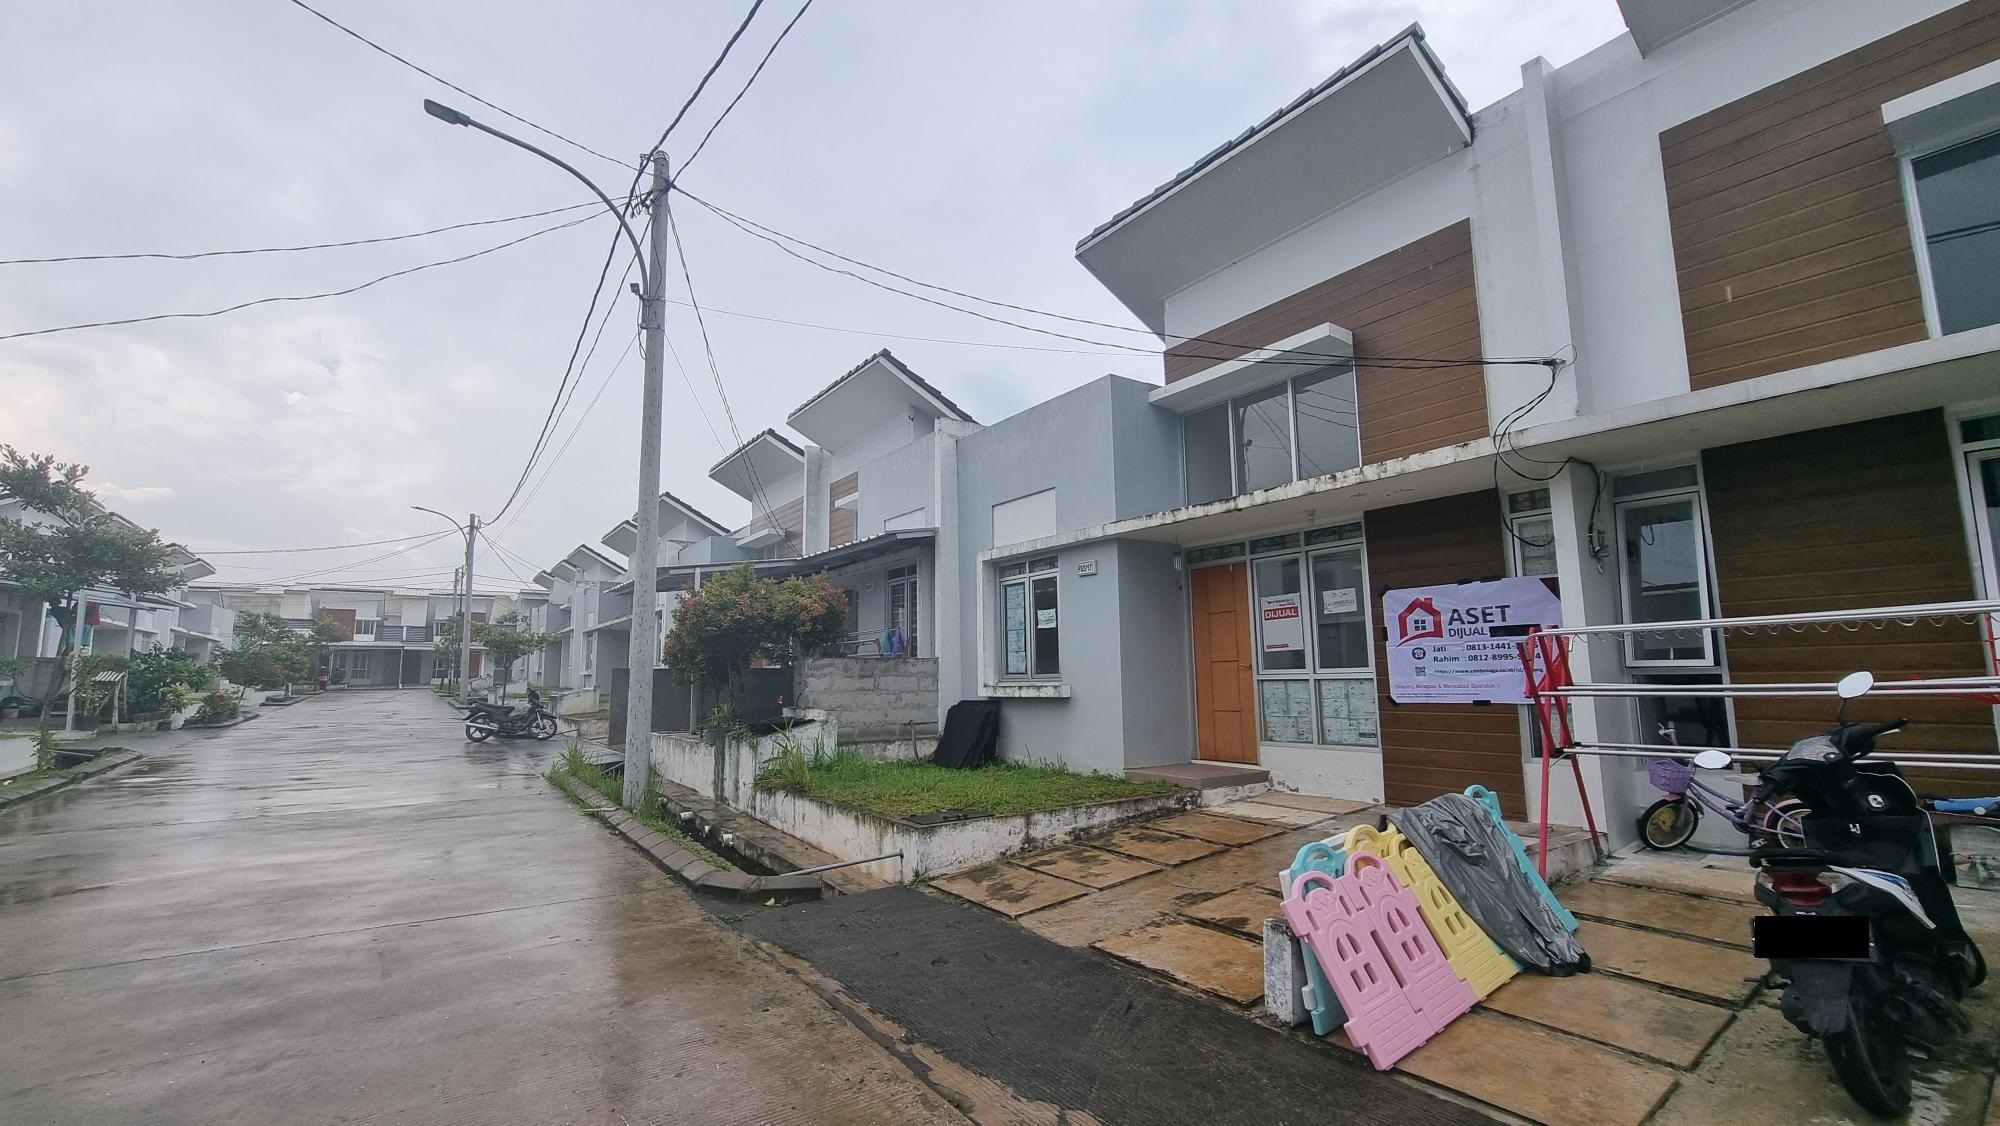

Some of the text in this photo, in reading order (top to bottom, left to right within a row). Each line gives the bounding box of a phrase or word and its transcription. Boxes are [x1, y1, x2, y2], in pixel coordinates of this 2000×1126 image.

[1265, 608, 1297, 619] DIJUAL
[1447, 604, 1511, 626] ASET
[1448, 626, 1489, 639] DIJUAL
[1432, 645, 1446, 653] Jati
[1433, 655, 1460, 663] Rahim
